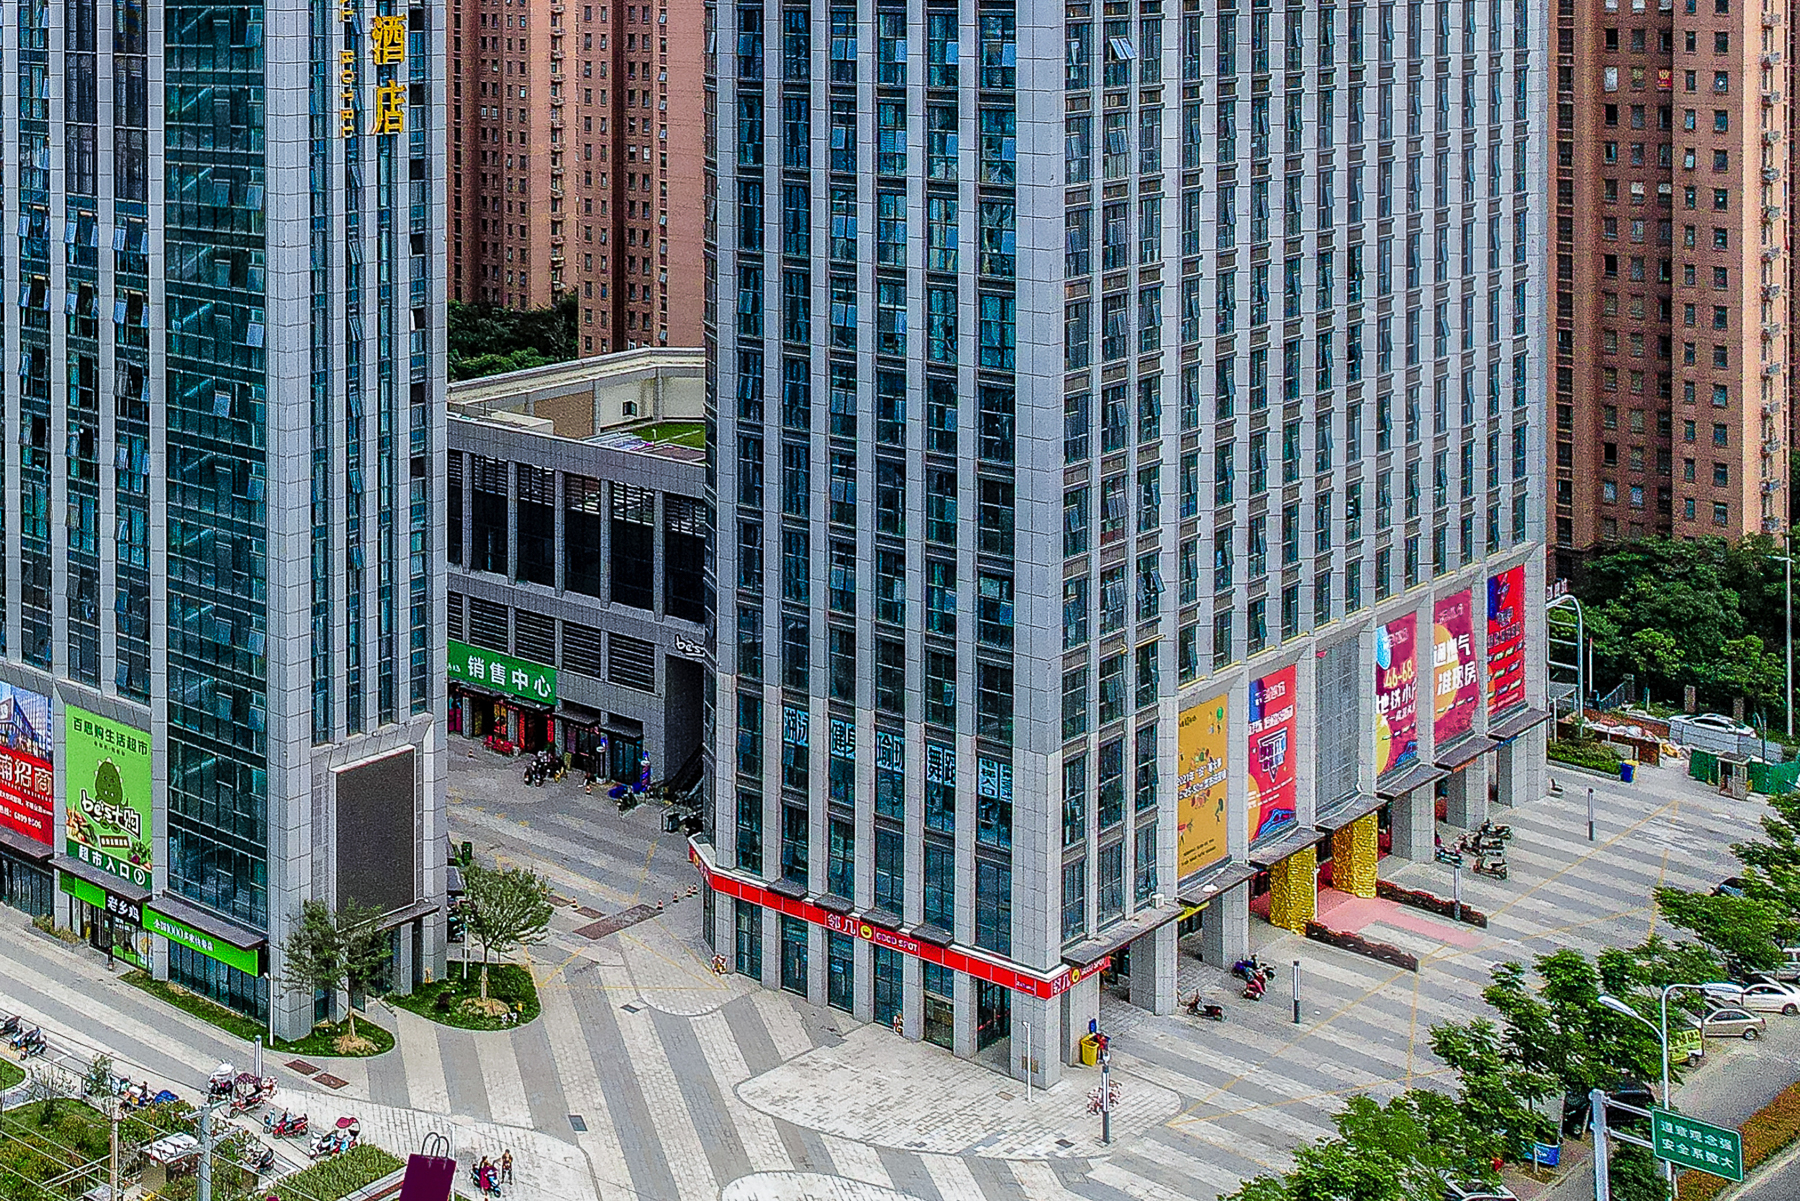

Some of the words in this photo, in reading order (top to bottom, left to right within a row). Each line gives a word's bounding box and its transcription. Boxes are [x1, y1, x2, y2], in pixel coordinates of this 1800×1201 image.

[339, 50, 354, 137] HOTEL
[468, 654, 551, 698] 销售中心
[73, 716, 148, 756] 百思购生活超市
[78, 844, 130, 880] 超市入口
[107, 895, 140, 922] 老乡鸡
[828, 913, 856, 935] 邻几
[1661, 1138, 1735, 1170] 安全系数大
